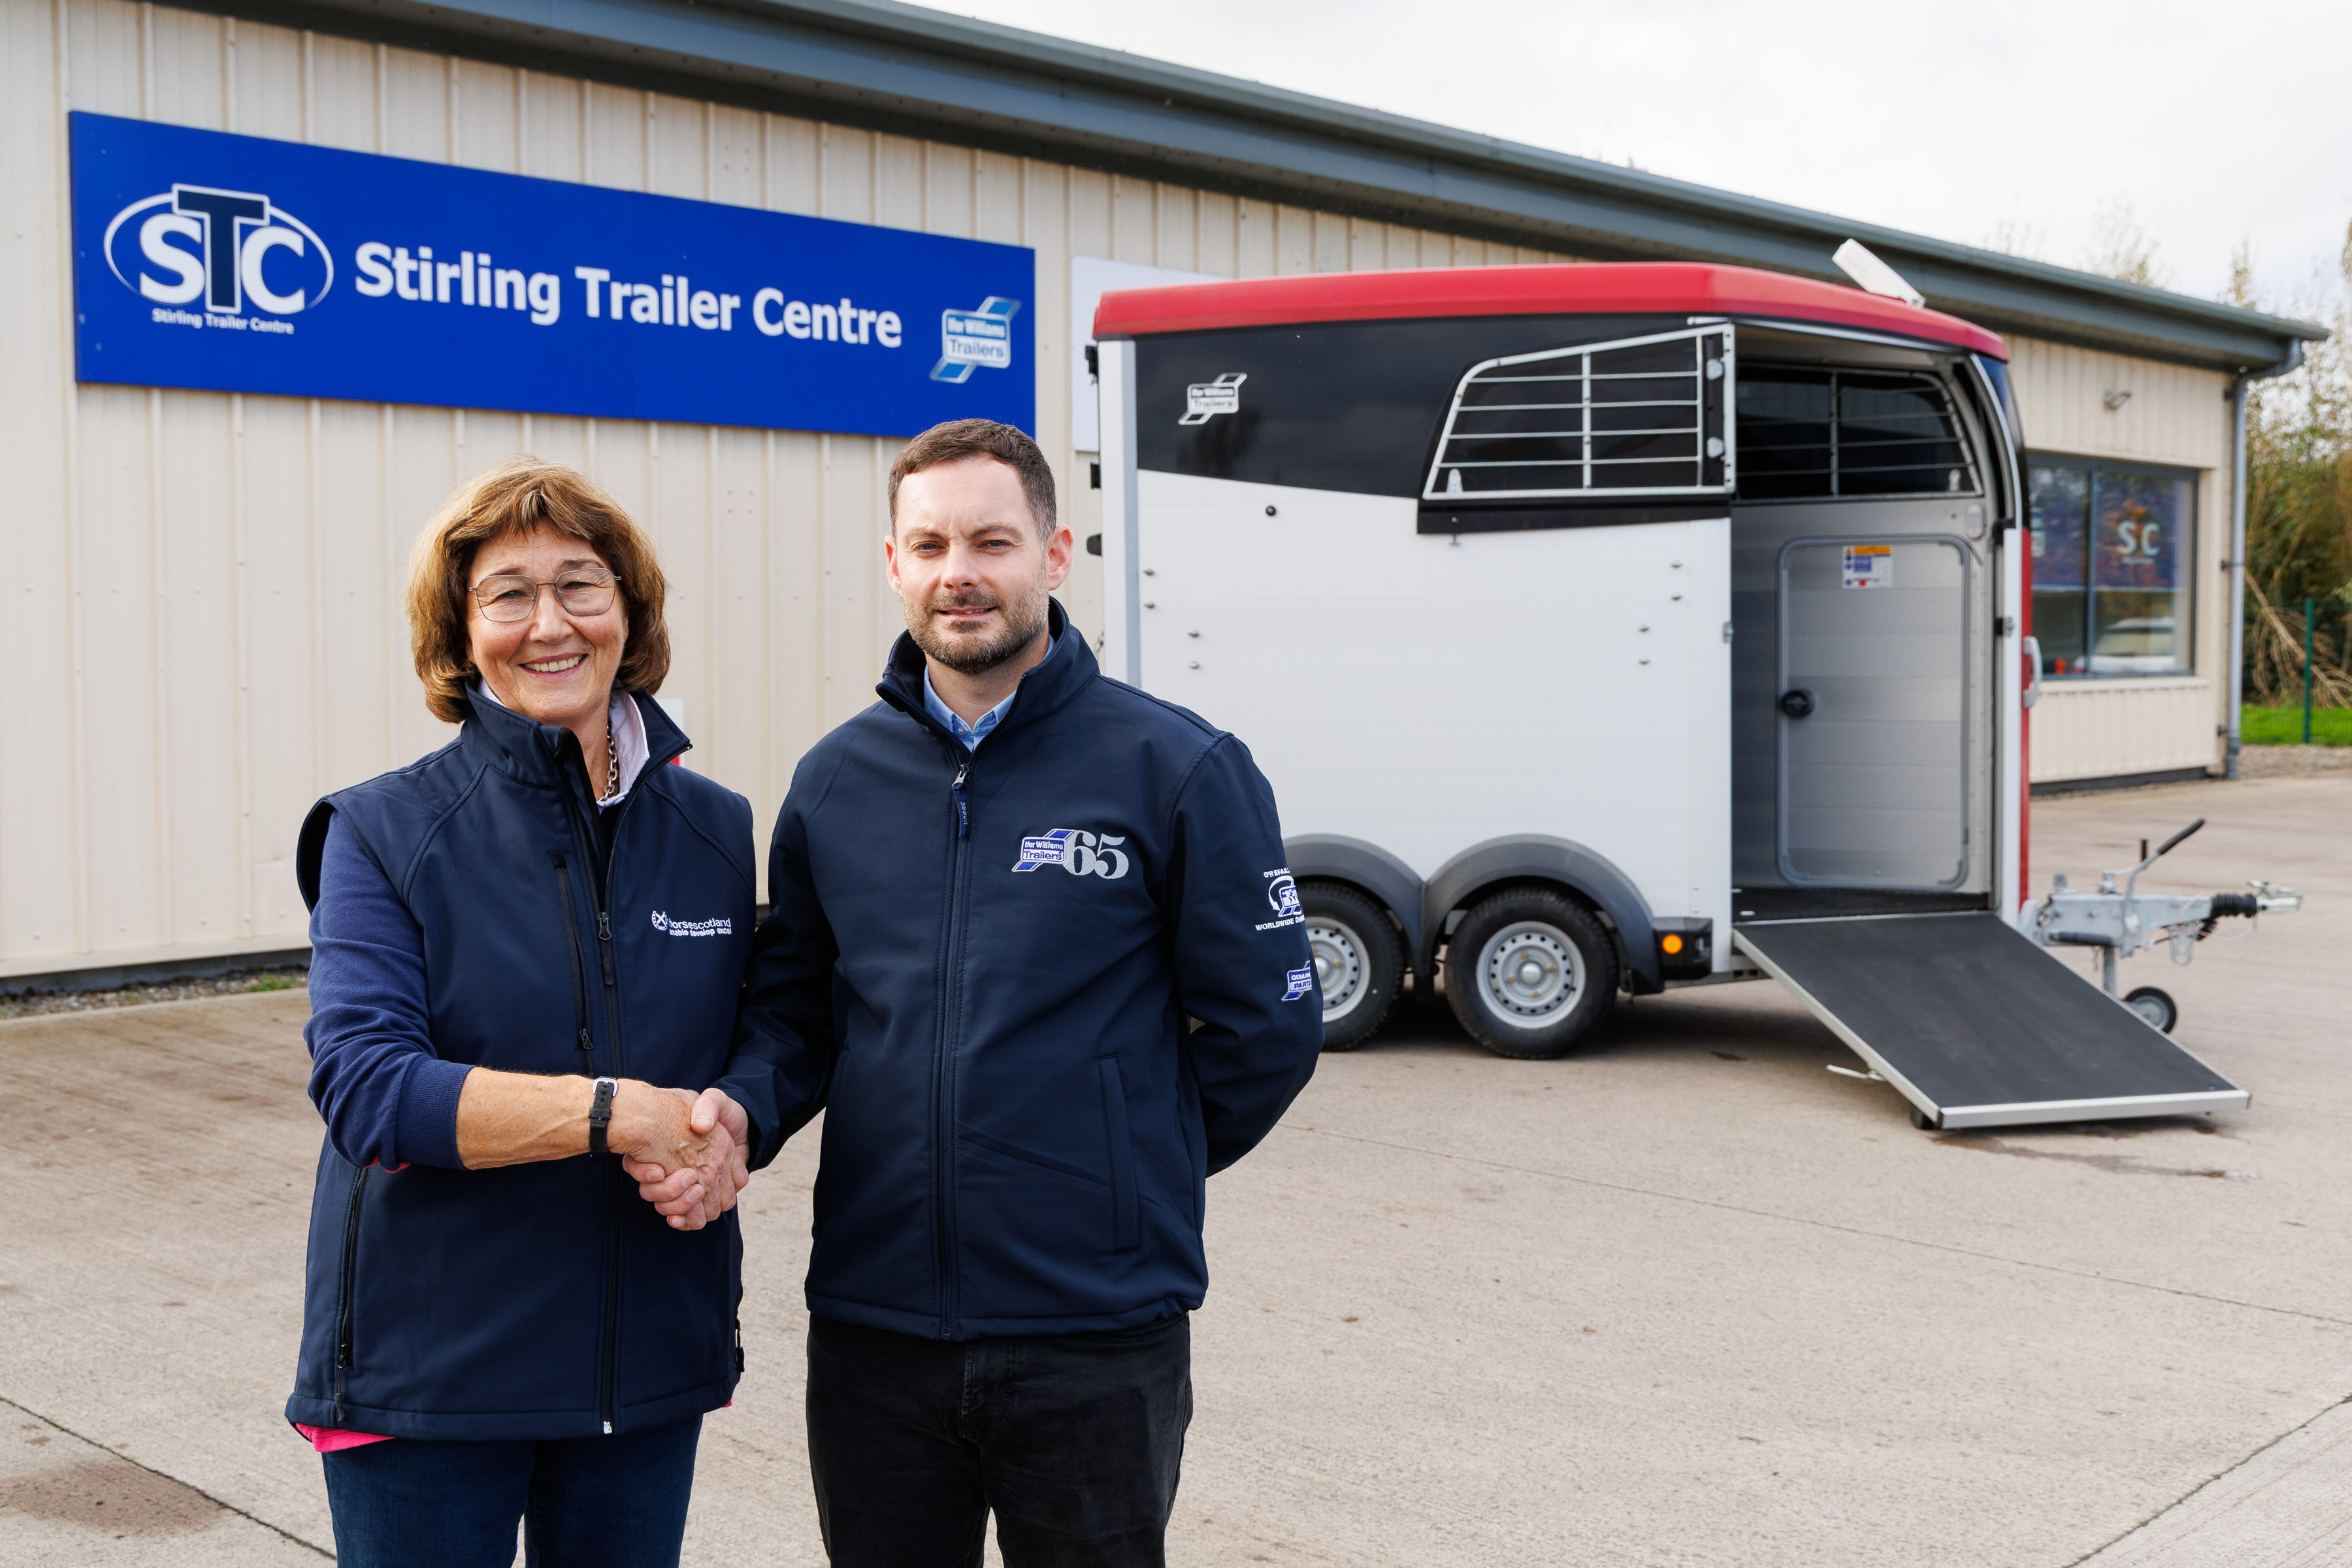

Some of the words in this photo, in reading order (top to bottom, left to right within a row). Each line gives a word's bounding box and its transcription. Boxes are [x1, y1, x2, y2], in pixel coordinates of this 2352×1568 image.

[139, 184, 305, 314] STC
[356, 242, 560, 325] Stirling
[575, 266, 740, 331] Trailer
[753, 287, 902, 348] Centre
[152, 308, 203, 329] Stirling
[204, 312, 249, 330] Trailer
[250, 316, 295, 335] Centre
[951, 339, 1004, 357] Trailers
[1036, 840, 1064, 850] Williams
[1023, 851, 1062, 860] Trailers
[1062, 830, 1130, 879] 65
[669, 918, 731, 930] horsescotland
[1255, 918, 1294, 930] WORLDWIDE
